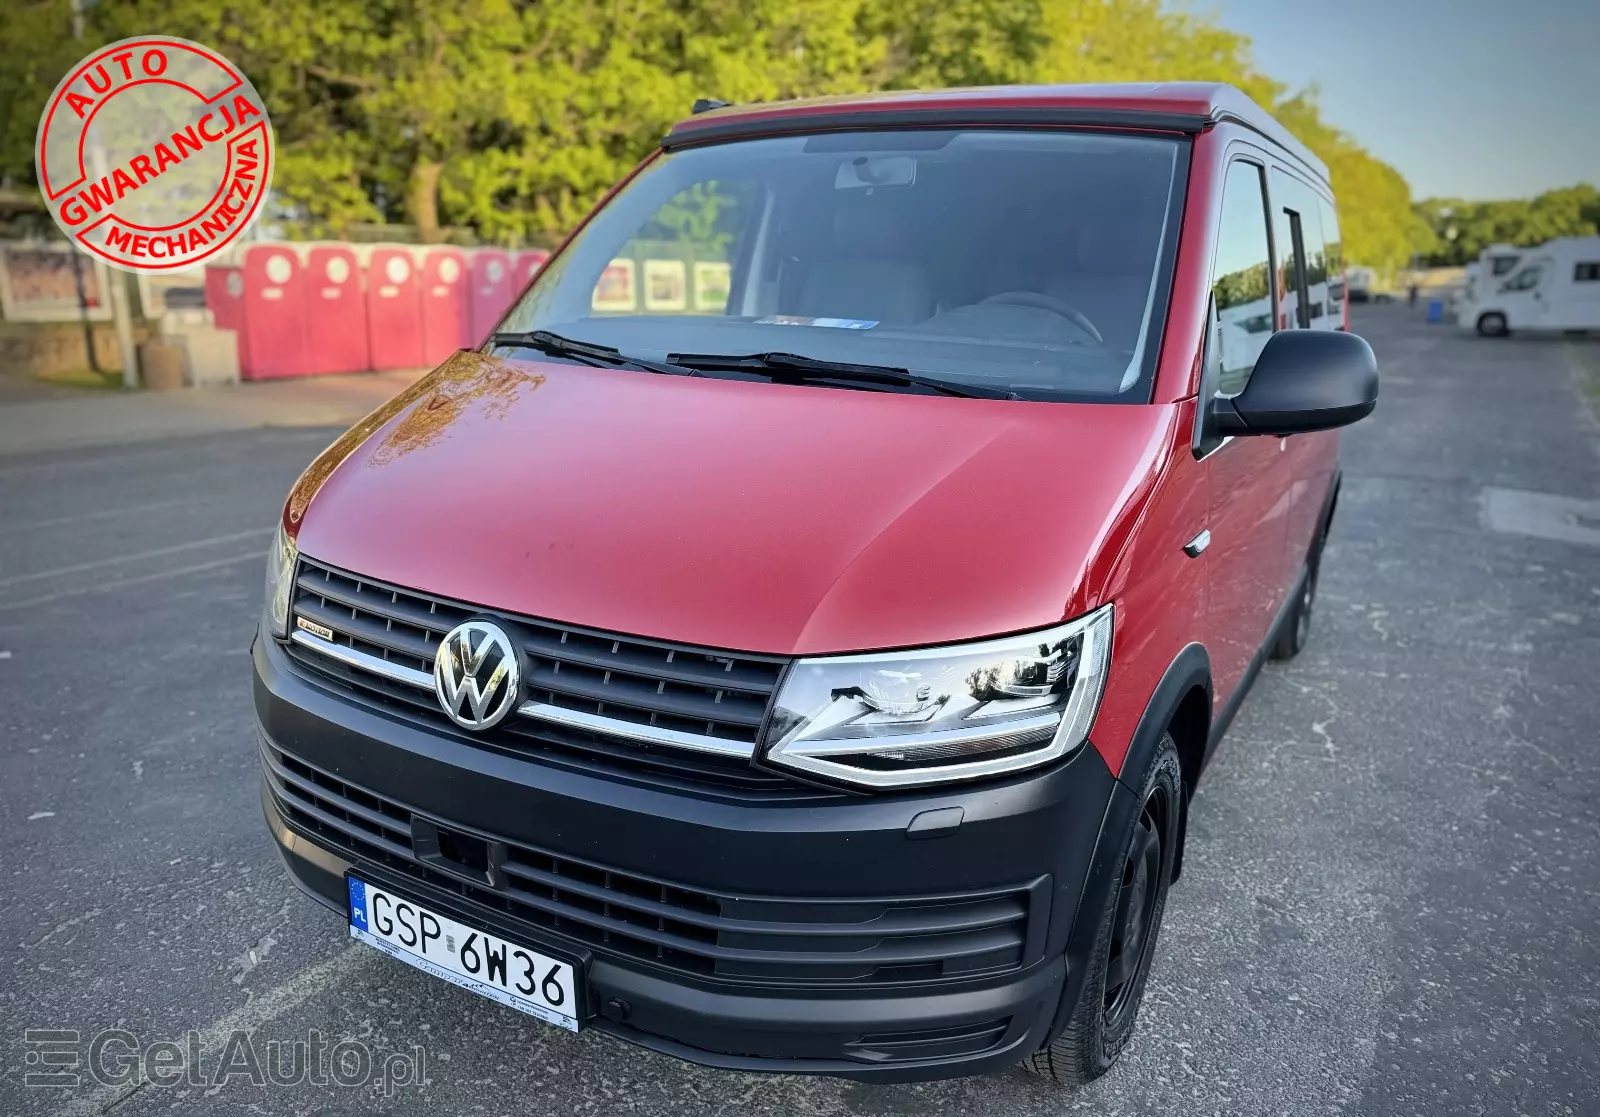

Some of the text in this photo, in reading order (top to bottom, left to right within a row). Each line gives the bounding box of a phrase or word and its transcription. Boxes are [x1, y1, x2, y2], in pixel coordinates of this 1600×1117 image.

[353, 906, 367, 923] PL
[372, 892, 565, 1007] GSP 6W36
